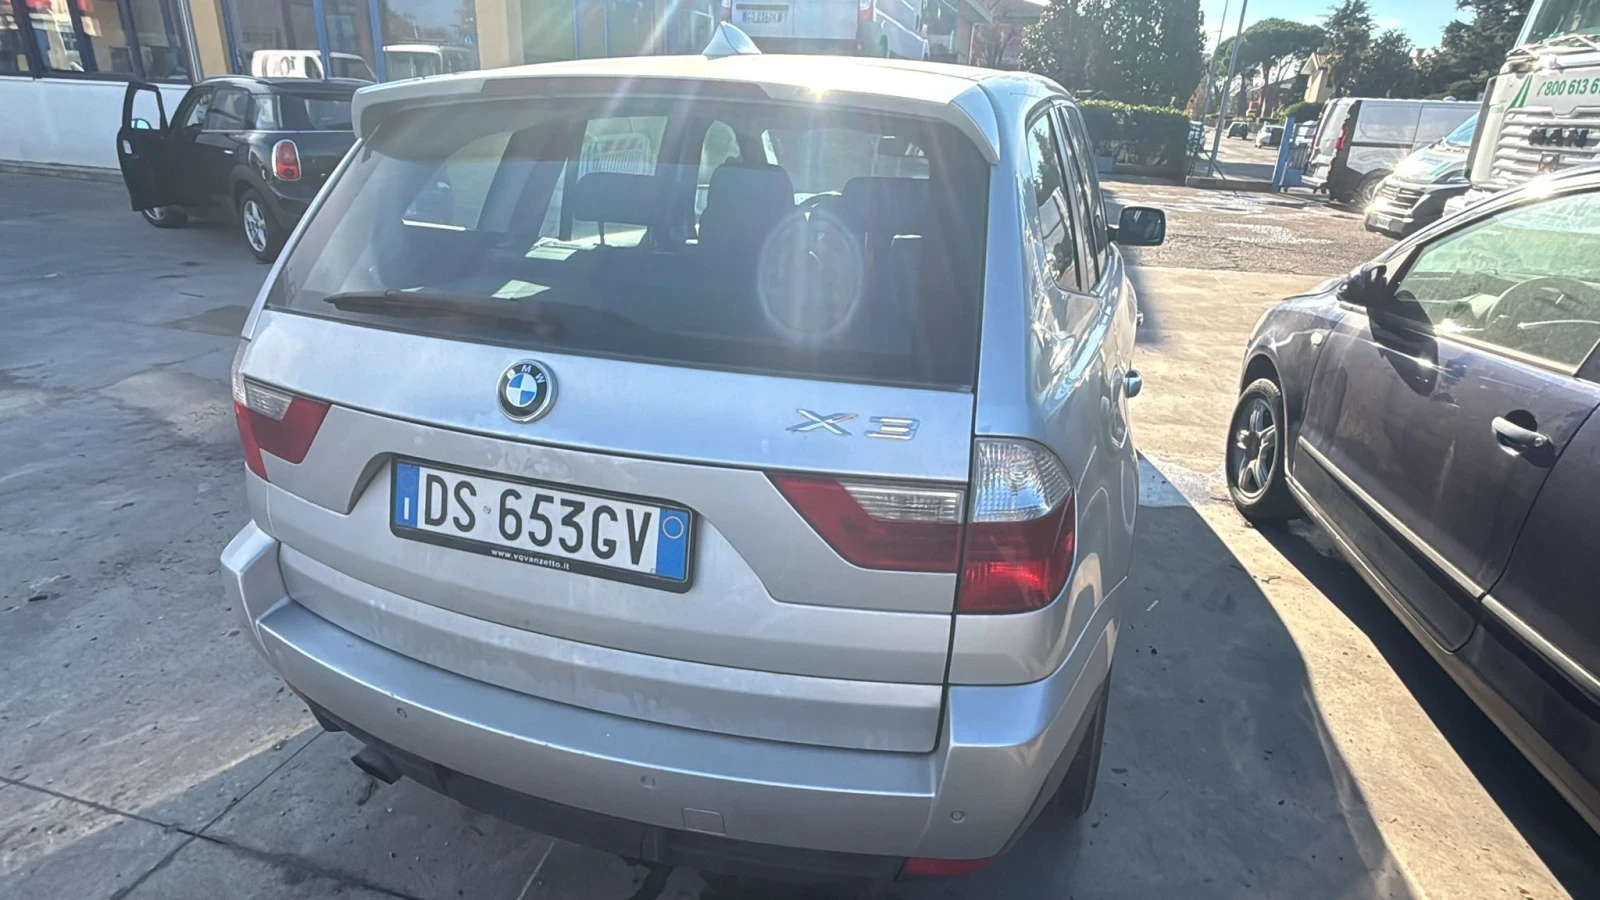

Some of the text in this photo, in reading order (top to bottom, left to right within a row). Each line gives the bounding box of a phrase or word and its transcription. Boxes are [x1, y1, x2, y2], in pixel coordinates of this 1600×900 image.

[1544, 77, 1600, 96] 800 613 6
[1527, 128, 1590, 148] MAN
[506, 364, 546, 384] BMW
[424, 473, 477, 533] DS
[498, 488, 653, 566] 653GV
